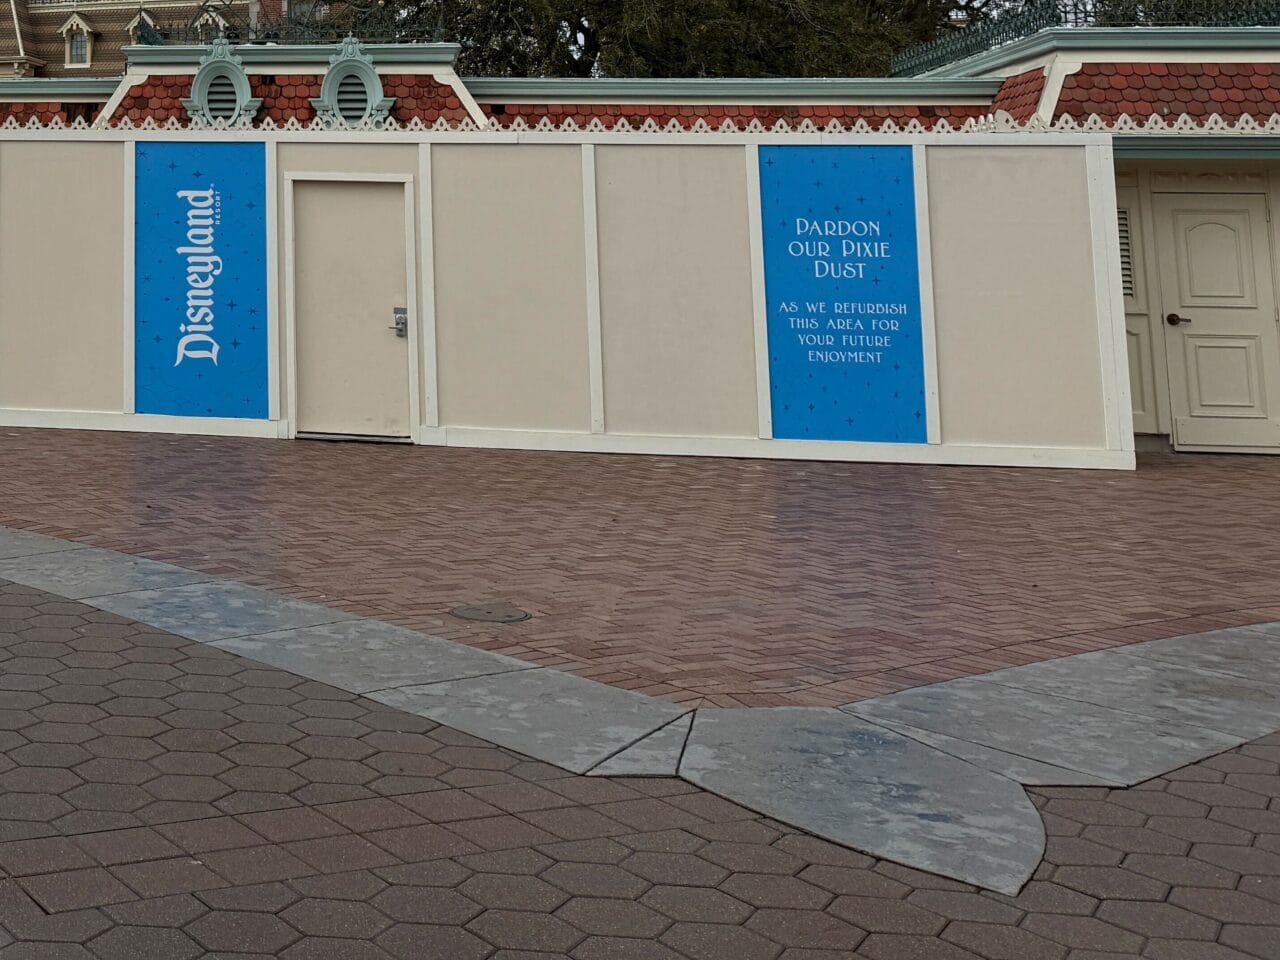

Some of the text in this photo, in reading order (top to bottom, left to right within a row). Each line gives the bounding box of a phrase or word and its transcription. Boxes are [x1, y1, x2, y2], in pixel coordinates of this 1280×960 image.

[796, 218, 881, 236] PARDON
[788, 239, 891, 258] OUR PIXIE
[174, 188, 223, 367] Disneyland
[814, 260, 866, 279] DUST
[779, 301, 907, 315] AS WE REFURBISH
[788, 317, 899, 331] THIS AREA FOR
[798, 334, 891, 347] YOUR FUTURE
[808, 350, 883, 364] ENJOYMENT
